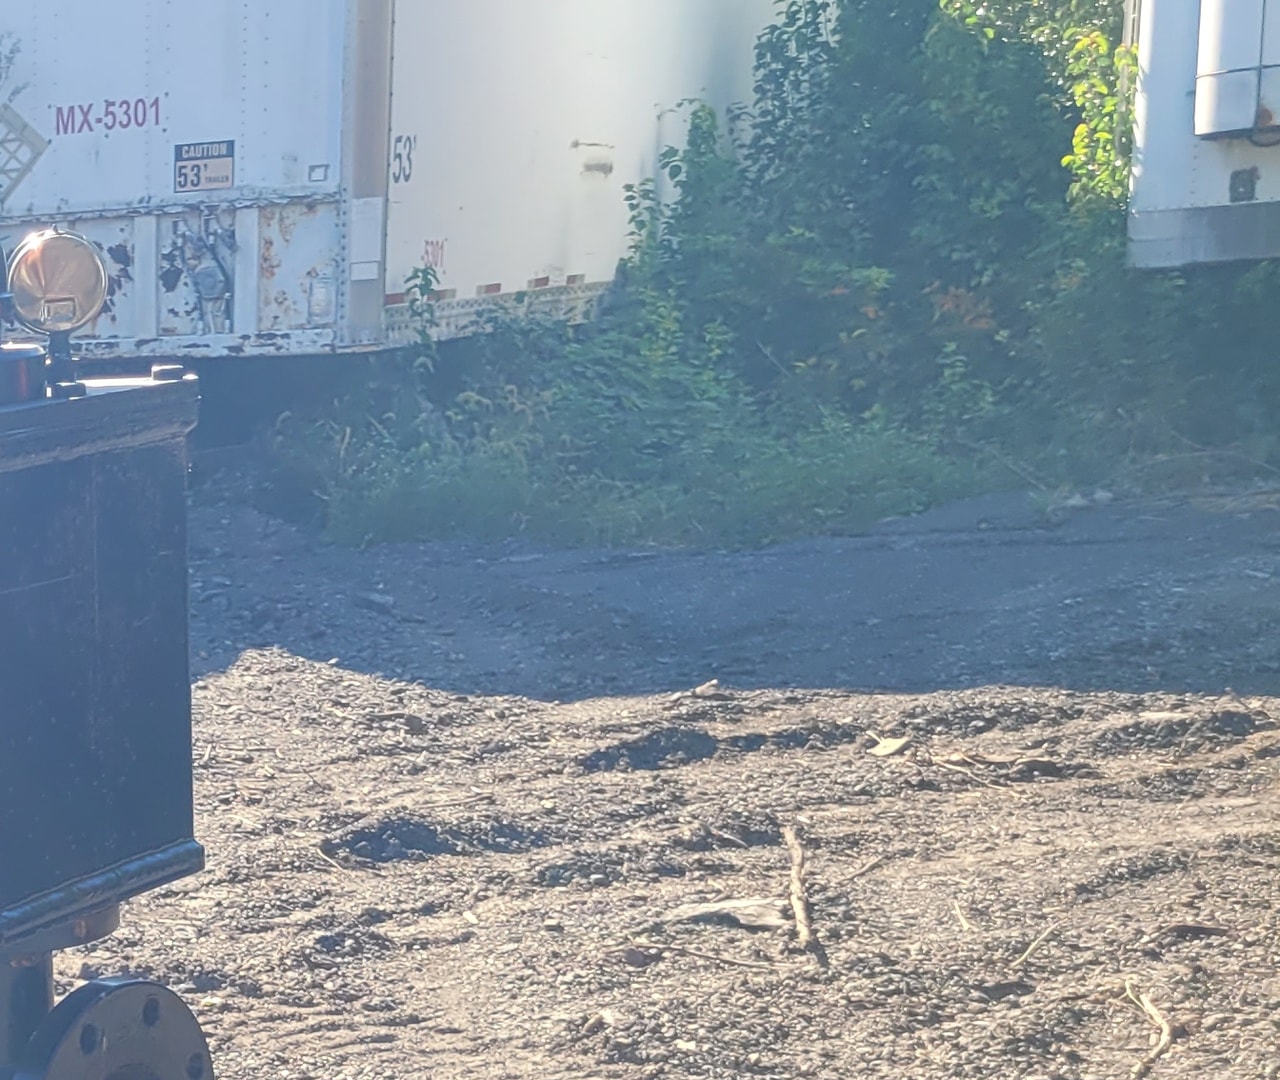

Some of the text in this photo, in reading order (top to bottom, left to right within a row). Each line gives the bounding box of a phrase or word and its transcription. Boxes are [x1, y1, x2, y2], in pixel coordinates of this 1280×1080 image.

[55, 96, 160, 136] MX-5301
[182, 143, 226, 158] CAUTION
[205, 175, 229, 183] TRAILER
